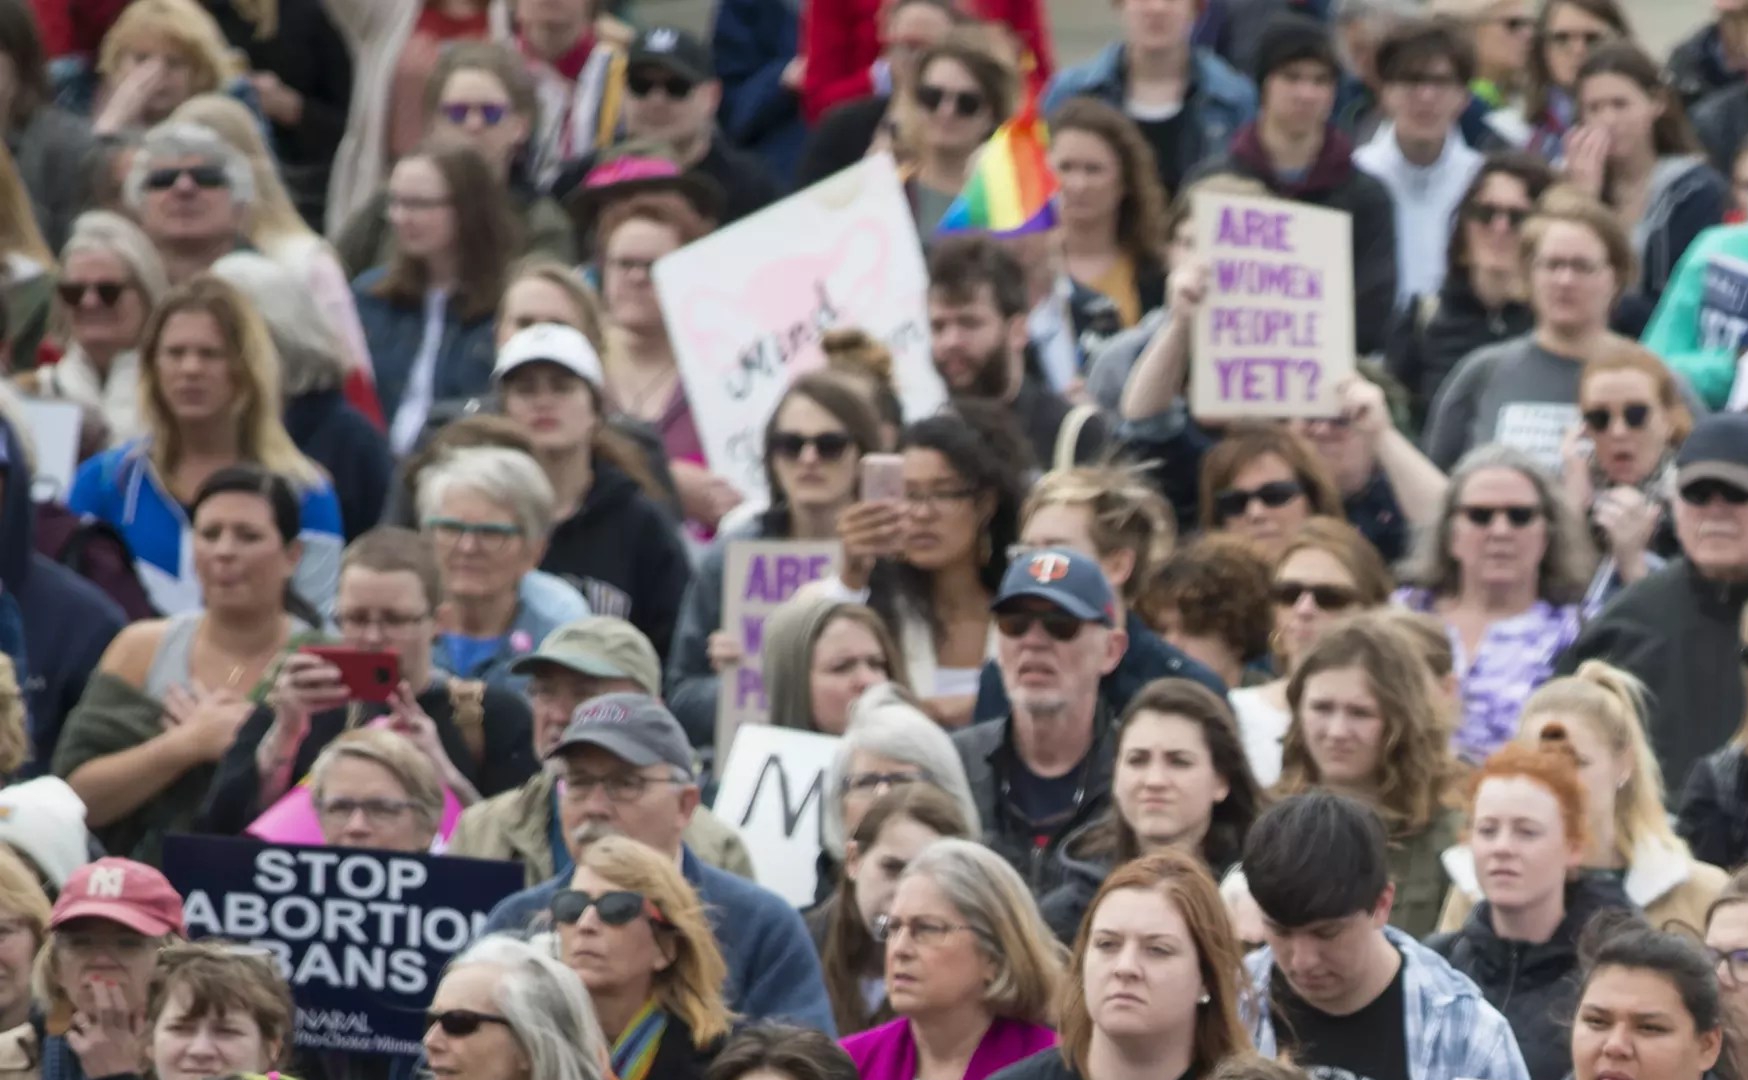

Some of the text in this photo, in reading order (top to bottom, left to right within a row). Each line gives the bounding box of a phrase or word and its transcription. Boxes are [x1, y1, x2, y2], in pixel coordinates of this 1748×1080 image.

[1216, 206, 1297, 252] ARE
[1214, 259, 1324, 299] WOMEN
[1212, 305, 1319, 347] PEOPLE
[1214, 355, 1321, 402] YET?
[254, 849, 428, 901] STOP
